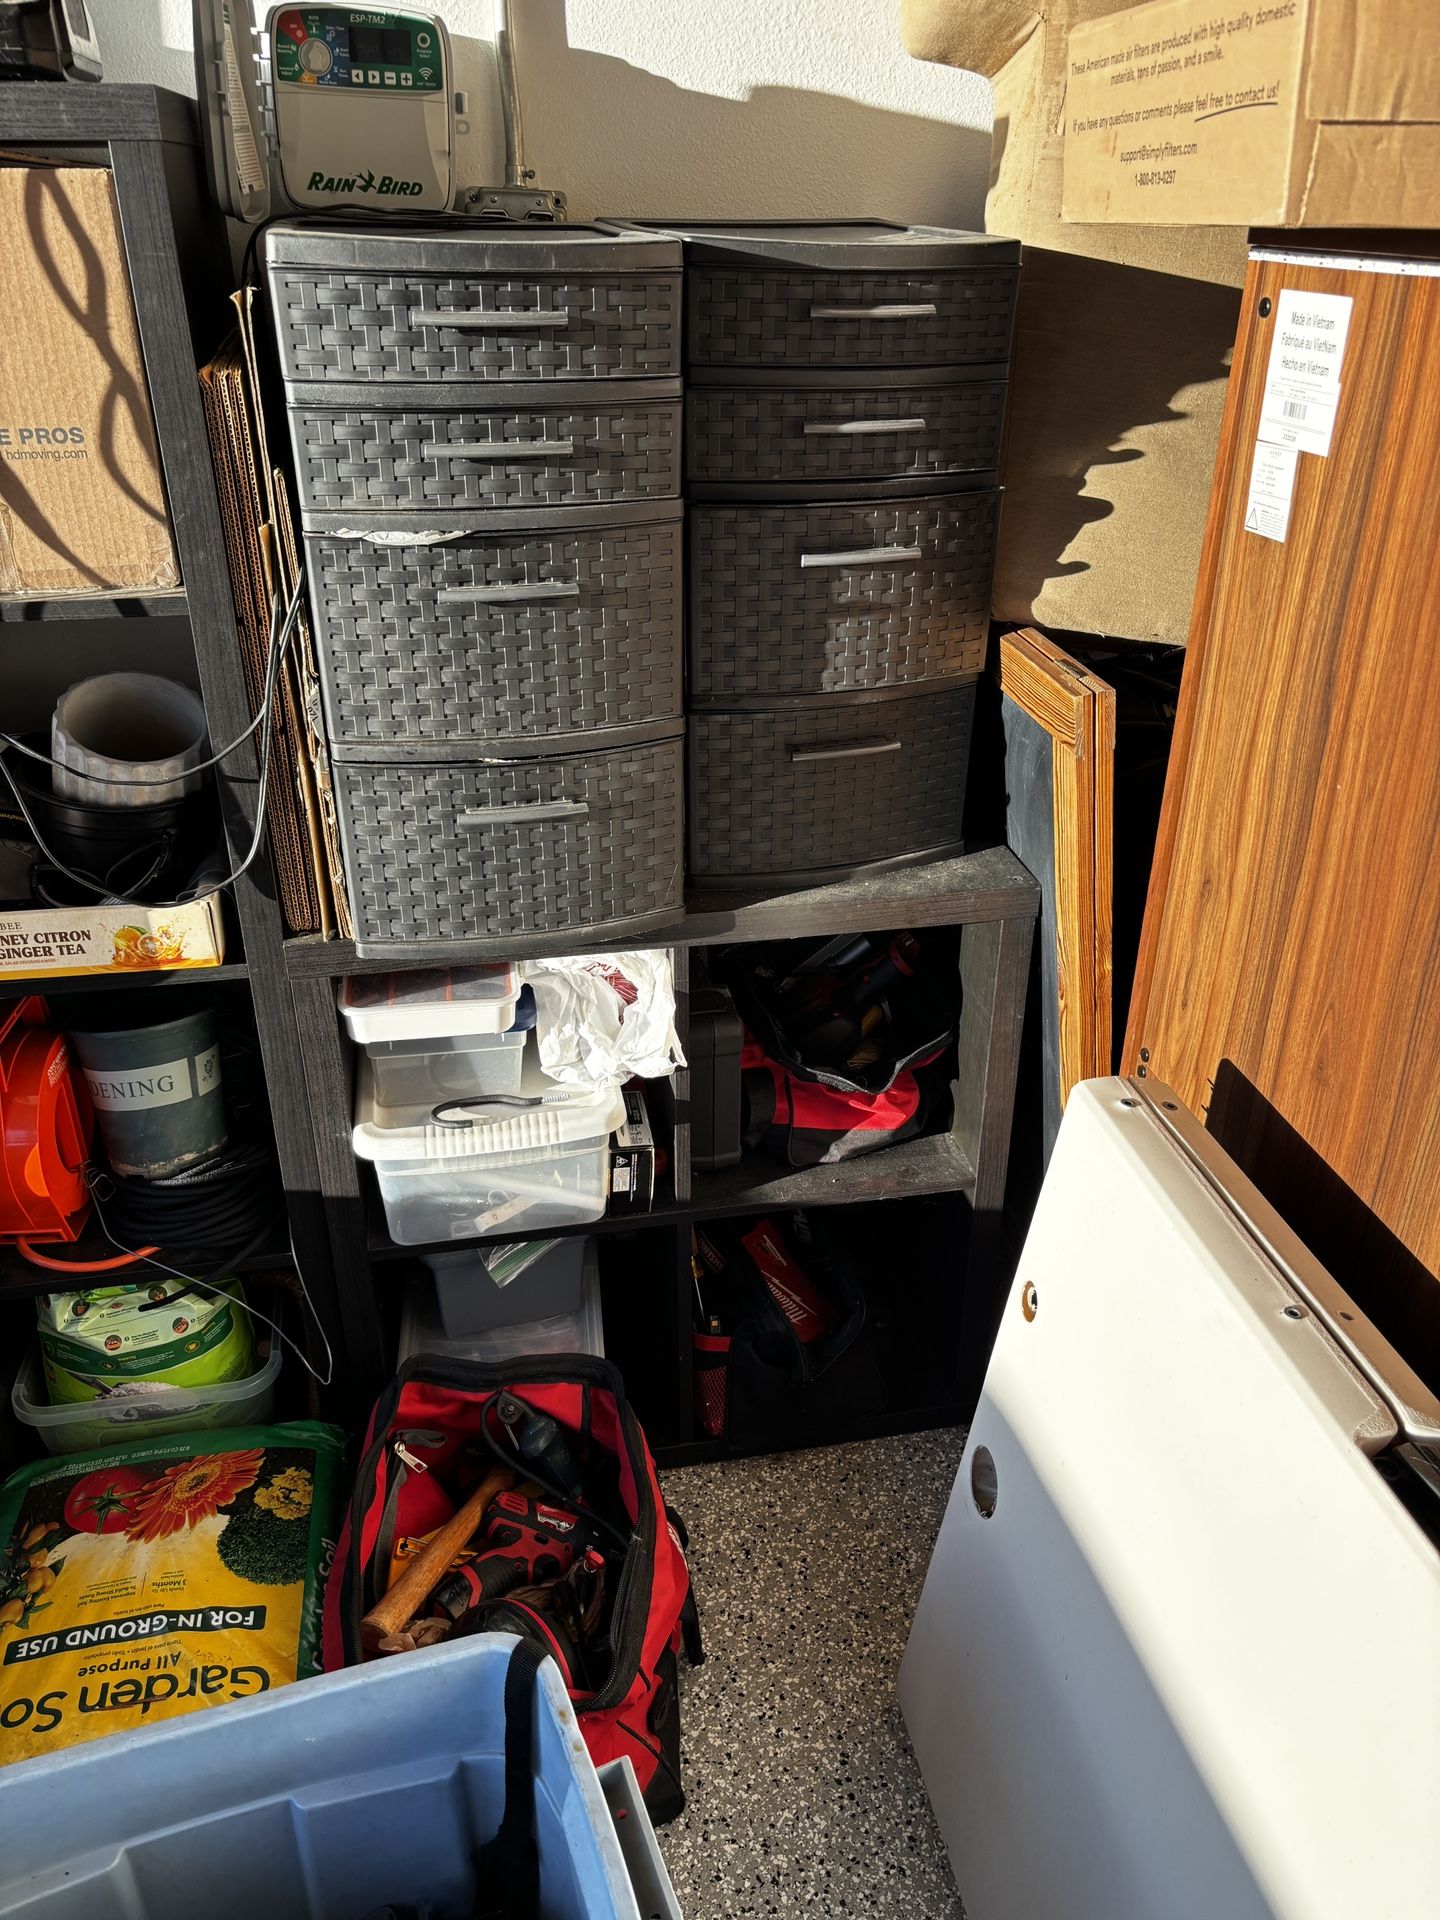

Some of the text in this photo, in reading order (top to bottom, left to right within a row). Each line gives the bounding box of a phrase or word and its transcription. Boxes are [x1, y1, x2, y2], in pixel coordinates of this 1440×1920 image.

[350, 14, 386, 25] ESP-TM2
[1072, 63, 1086, 76] These
[1087, 56, 1110, 71] American
[1110, 49, 1125, 65] made
[1134, 44, 1150, 58] filters
[1151, 42, 1160, 54] are
[1162, 27, 1193, 55] produced
[1194, 23, 1208, 42] with
[1210, 18, 1225, 40] high
[1227, 12, 1254, 37] quality
[1256, 1, 1296, 25] domestic
[1110, 67, 1136, 86] materials,
[1136, 66, 1150, 80] tons
[1150, 60, 1157, 76] of
[1157, 56, 1182, 78] passion,
[1184, 49, 1197, 68] and
[1203, 44, 1224, 63] smile.
[1072, 79, 1280, 136] If you have any questions or comments please feel free to contact us!
[1120, 142, 1198, 165] support@simplyfilters.com
[307, 171, 424, 196] RAIN BIRD
[1290, 311, 1335, 331] Made in Vietnam
[1281, 332, 1305, 351] Fabriqué
[1305, 339, 1313, 350] au
[1281, 354, 1330, 378] Hecho en Vietnam
[18, 426, 85, 445] PROS
[6, 448, 88, 461] hdmoving.com
[0, 930, 92, 946] NEY CITRON
[0, 944, 86, 960] GINGER TEA
[91, 1074, 174, 1100] DENING
[115, 1586, 129, 1594] Build
[152, 1578, 188, 1588] 3 Months
[88, 1596, 110, 1604] Existing
[96, 1589, 114, 1597] Strong
[110, 1591, 136, 1600] Improves
[15, 1610, 255, 1658] FOR IN-GROUND USE
[154, 1641, 166, 1649] para
[78, 1651, 182, 1677] All Purpose
[0, 1664, 271, 1734] Garden So
